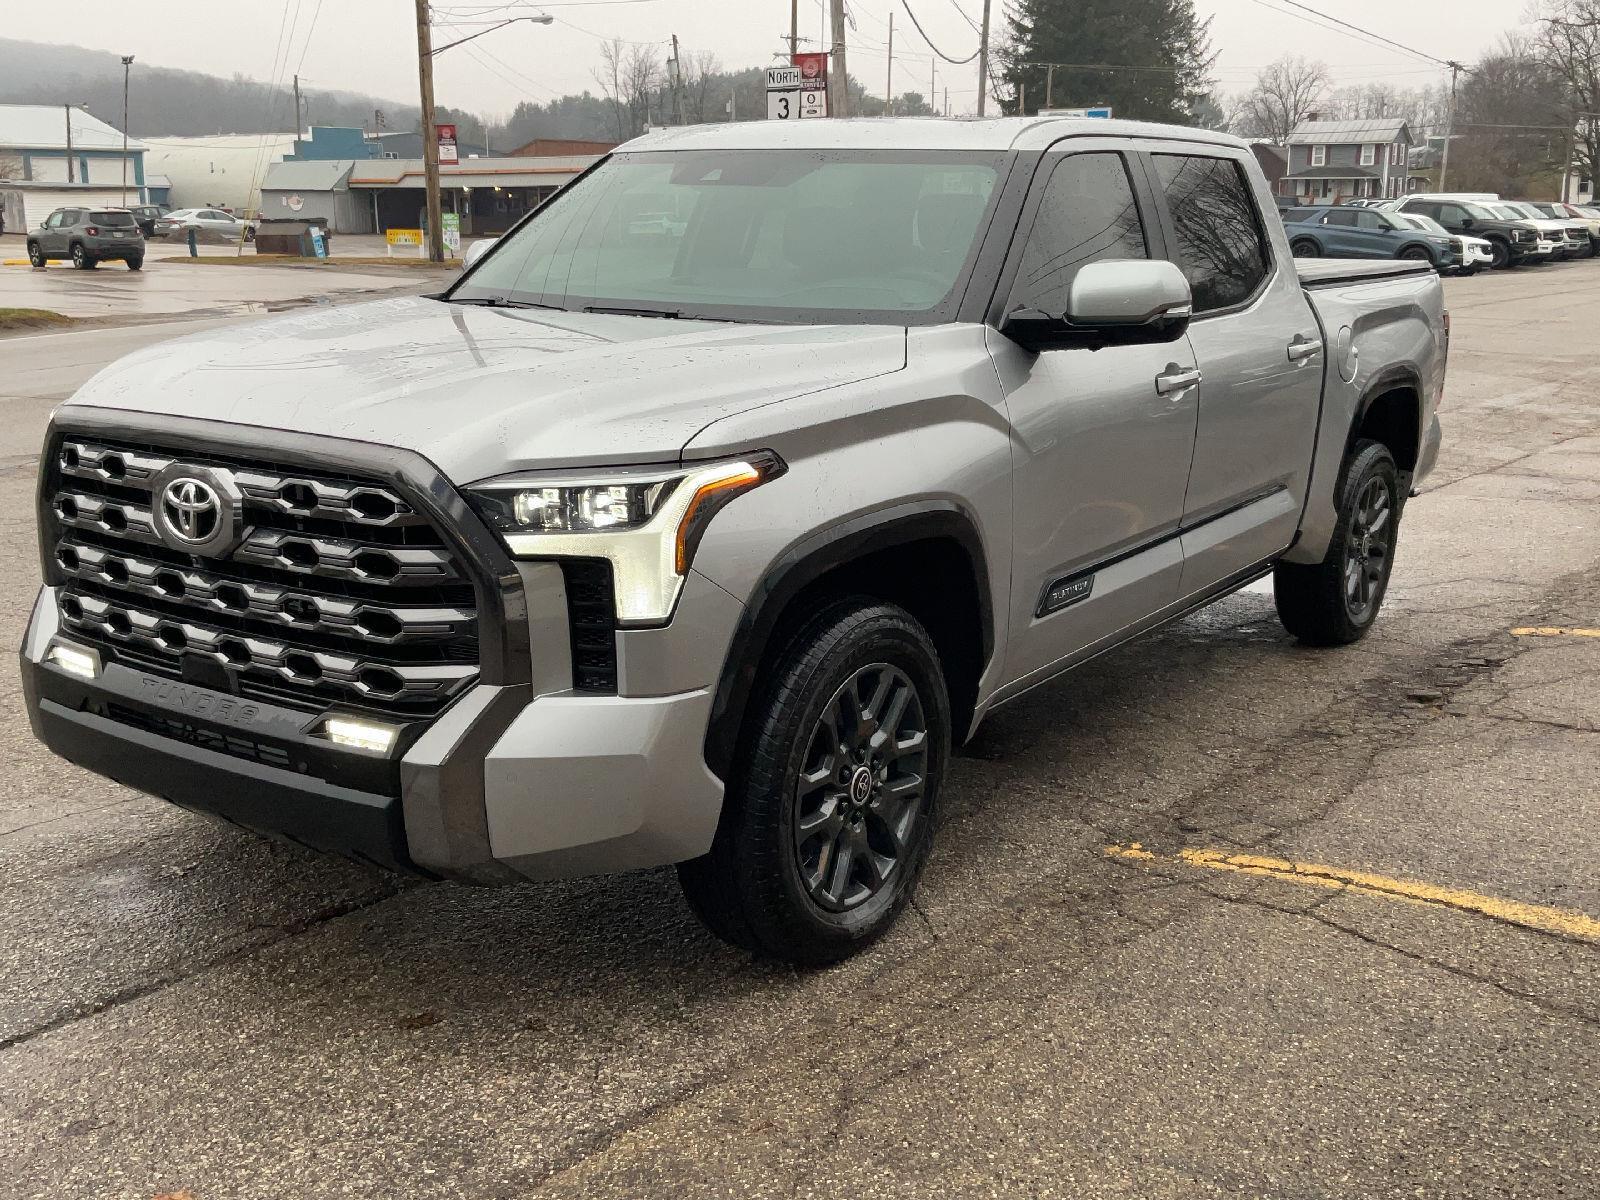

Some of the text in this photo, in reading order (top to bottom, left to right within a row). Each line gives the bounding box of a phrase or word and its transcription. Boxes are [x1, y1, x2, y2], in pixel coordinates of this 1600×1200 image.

[768, 71, 799, 84] NORTH
[777, 97, 789, 119] 3
[142, 677, 260, 725] TUNDRA
